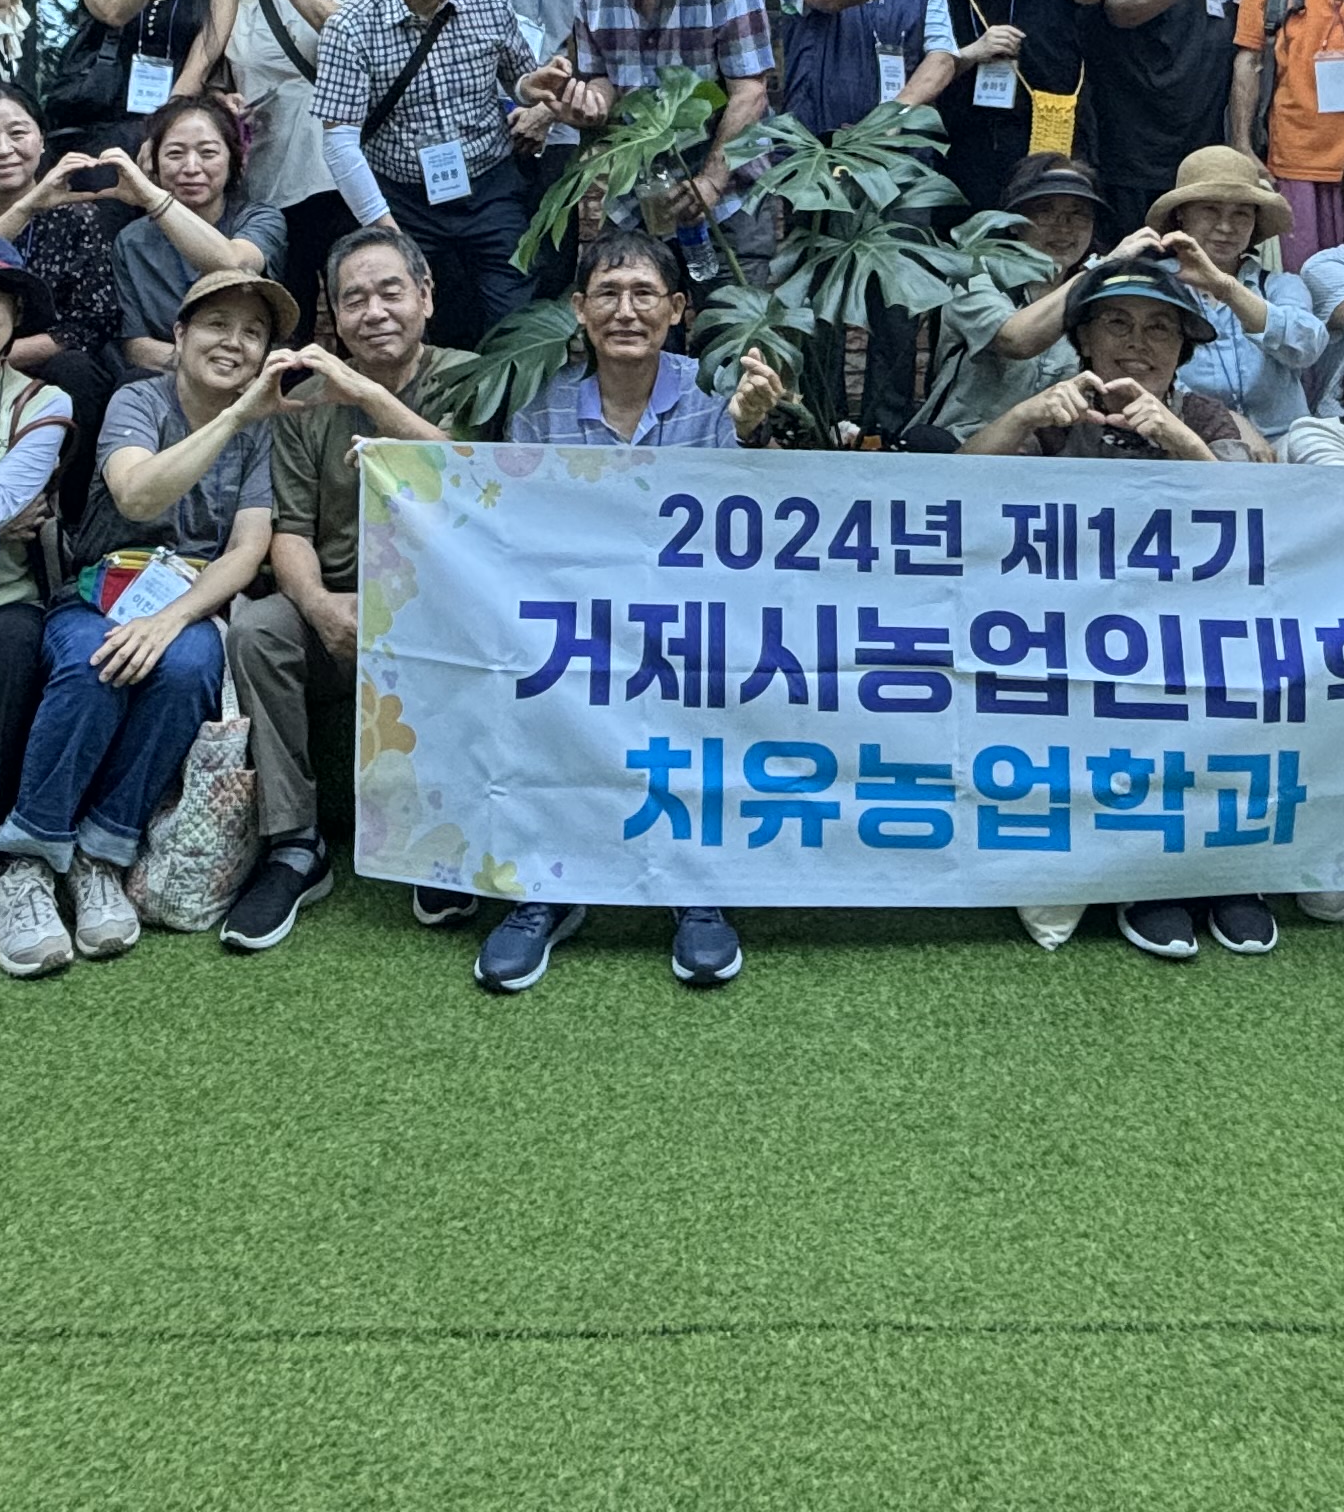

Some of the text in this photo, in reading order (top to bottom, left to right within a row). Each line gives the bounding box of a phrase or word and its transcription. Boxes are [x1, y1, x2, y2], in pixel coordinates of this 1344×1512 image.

[657, 493, 1266, 587] 2024년 제14기
[623, 736, 1308, 854] 치유농업학과
